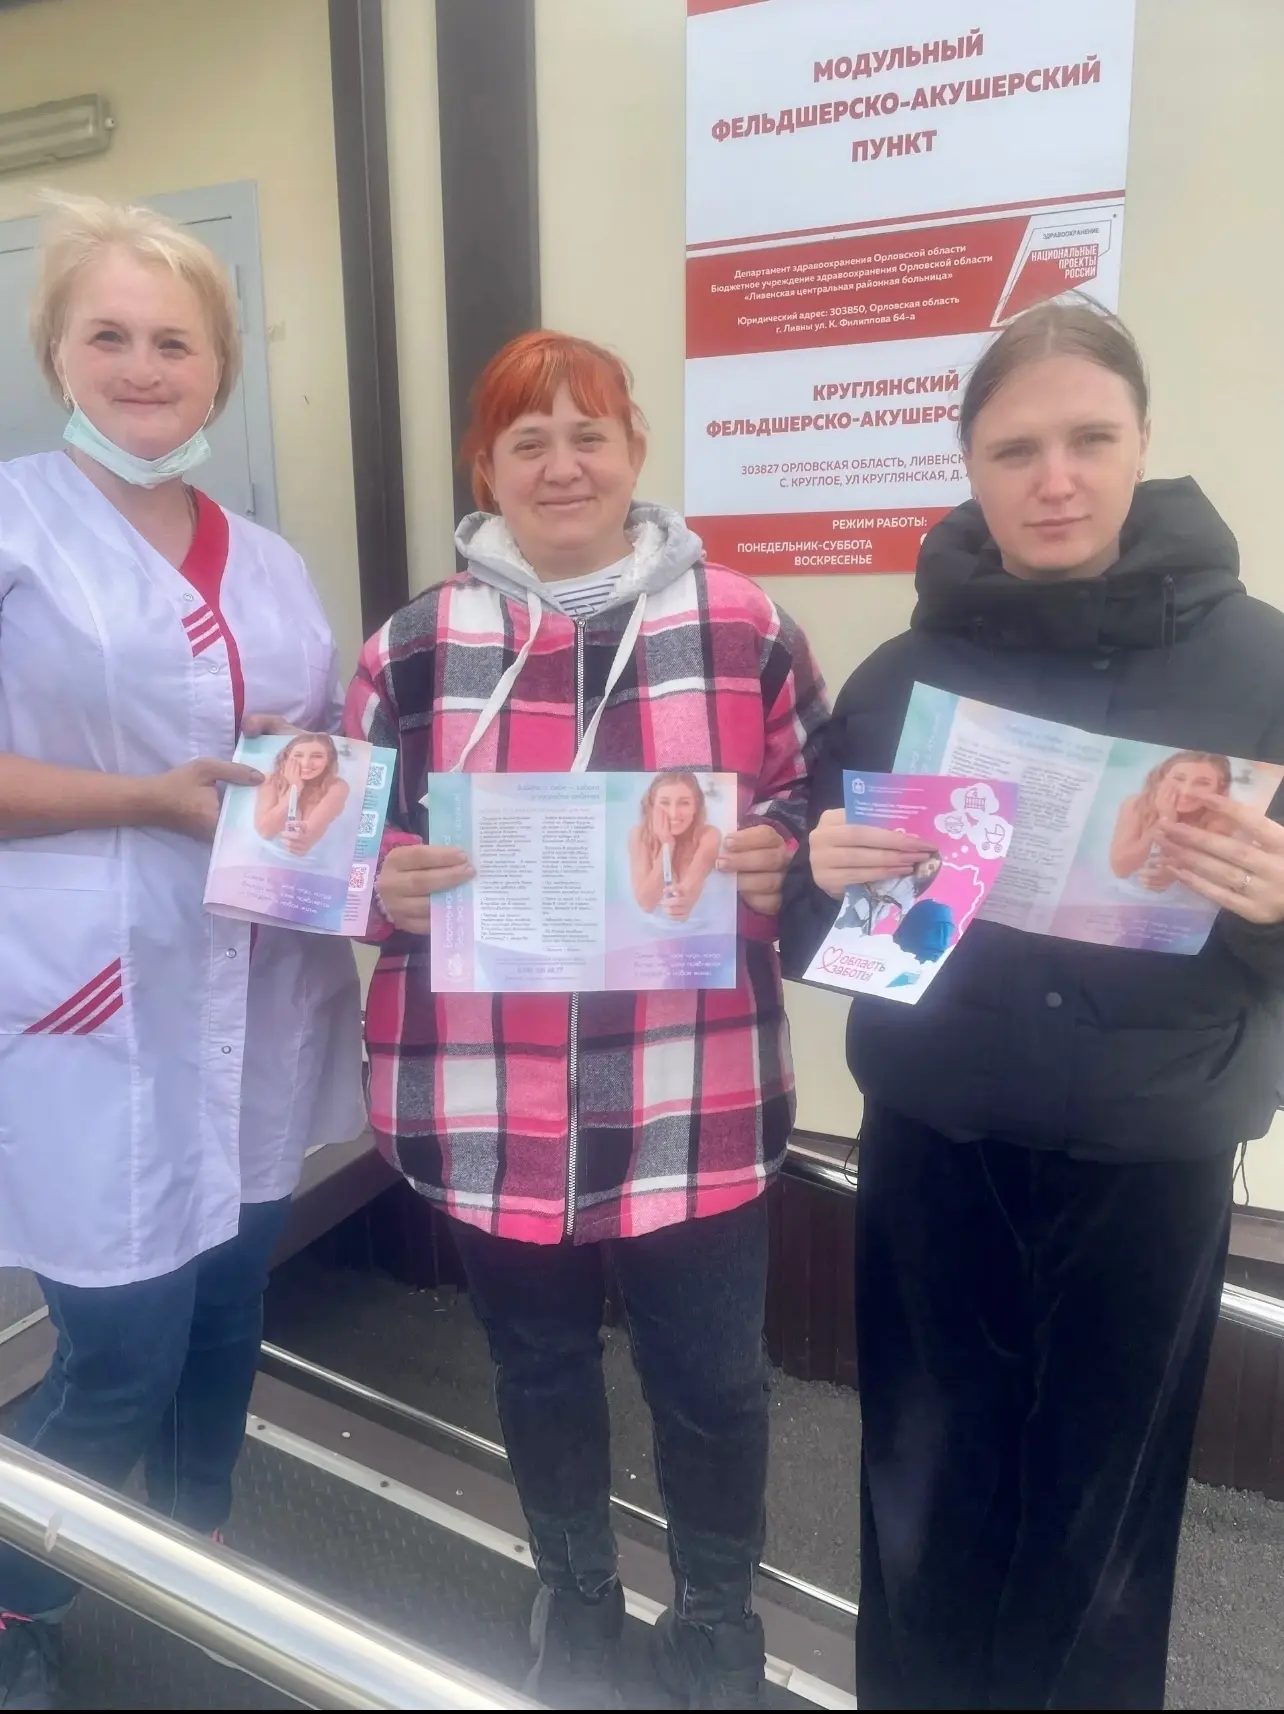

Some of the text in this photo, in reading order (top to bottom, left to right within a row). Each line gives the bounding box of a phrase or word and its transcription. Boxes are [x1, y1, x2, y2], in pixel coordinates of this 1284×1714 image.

[813, 27, 984, 83] МОДУЛЬНЫЙ
[711, 54, 1101, 142] ФЕЛЬДШЕРСКО-АКУШЕРСКИЙ
[851, 129, 938, 162] ПУНКТ
[1042, 228, 1100, 240] ЗДРАВООХРАНЕНИЕ
[734, 245, 967, 279] Департамент здравоохранения Орловской области
[1031, 245, 1098, 262] НАЦИОНАЛЬНЫЕ
[1058, 255, 1097, 269] ПРОЕКТЫ
[711, 255, 993, 293] Бюджетное учреждение здравоохранения Орловской области
[1064, 266, 1097, 279] РОССИИ
[744, 273, 953, 301] «Ливенская центральная районная больница»
[737, 296, 960, 326] Юридический адрес: 303850, Орловская область
[783, 322, 813, 333] Ливны
[814, 321, 827, 332] ул.
[829, 319, 838, 329] К.
[839, 315, 891, 327] Филиппова
[892, 312, 916, 322] 64-а
[812, 369, 959, 402] КРУГЛЯНСКИЙ
[706, 404, 962, 438] ФЕЛЬДШЕРСКО-АКУШЕРС
[741, 463, 779, 475] 303827
[781, 459, 849, 473] ОРЛОВСКАЯ
[851, 457, 907, 471] ОБЛАСТЬ,
[780, 478, 789, 488] С.
[791, 475, 843, 488] КРУГЛОЕ,
[845, 474, 860, 486] УЛ
[862, 470, 948, 484] КРУГЛЯНСКАЯ,
[950, 469, 963, 481] Д.
[832, 516, 928, 530] РЕЖИМ РАБОТЫ:
[737, 539, 873, 554] ПОНЕДЕЛЬНИК-СУББОТА
[794, 554, 873, 566] ВОСКРЕСЕНЬЕ
